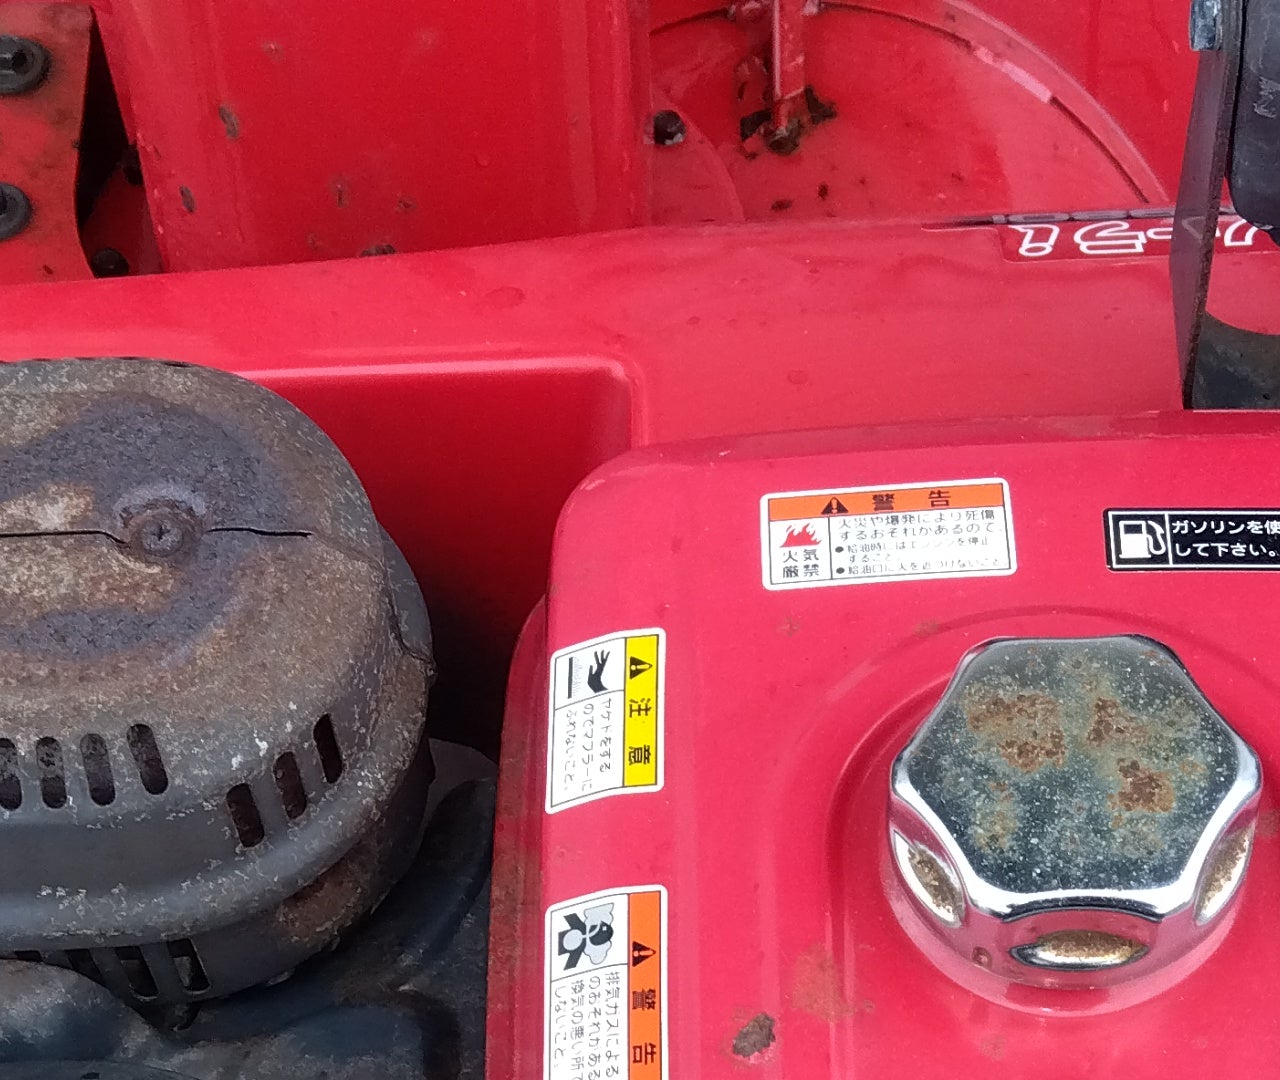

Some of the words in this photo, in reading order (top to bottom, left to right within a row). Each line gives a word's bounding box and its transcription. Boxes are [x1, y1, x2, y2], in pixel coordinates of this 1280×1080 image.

[871, 490, 951, 511] 警告
[782, 549, 819, 563] 火気
[782, 564, 820, 578] 厳禁
[1175, 543, 1278, 557] して下さい。
[564, 710, 578, 791] ふれないこと。
[581, 703, 595, 792] のでマフラーに
[599, 697, 612, 772] ヤケドをする
[628, 697, 652, 766] 注意
[553, 986, 568, 1069] しないこと。
[631, 988, 657, 1065] 警告
